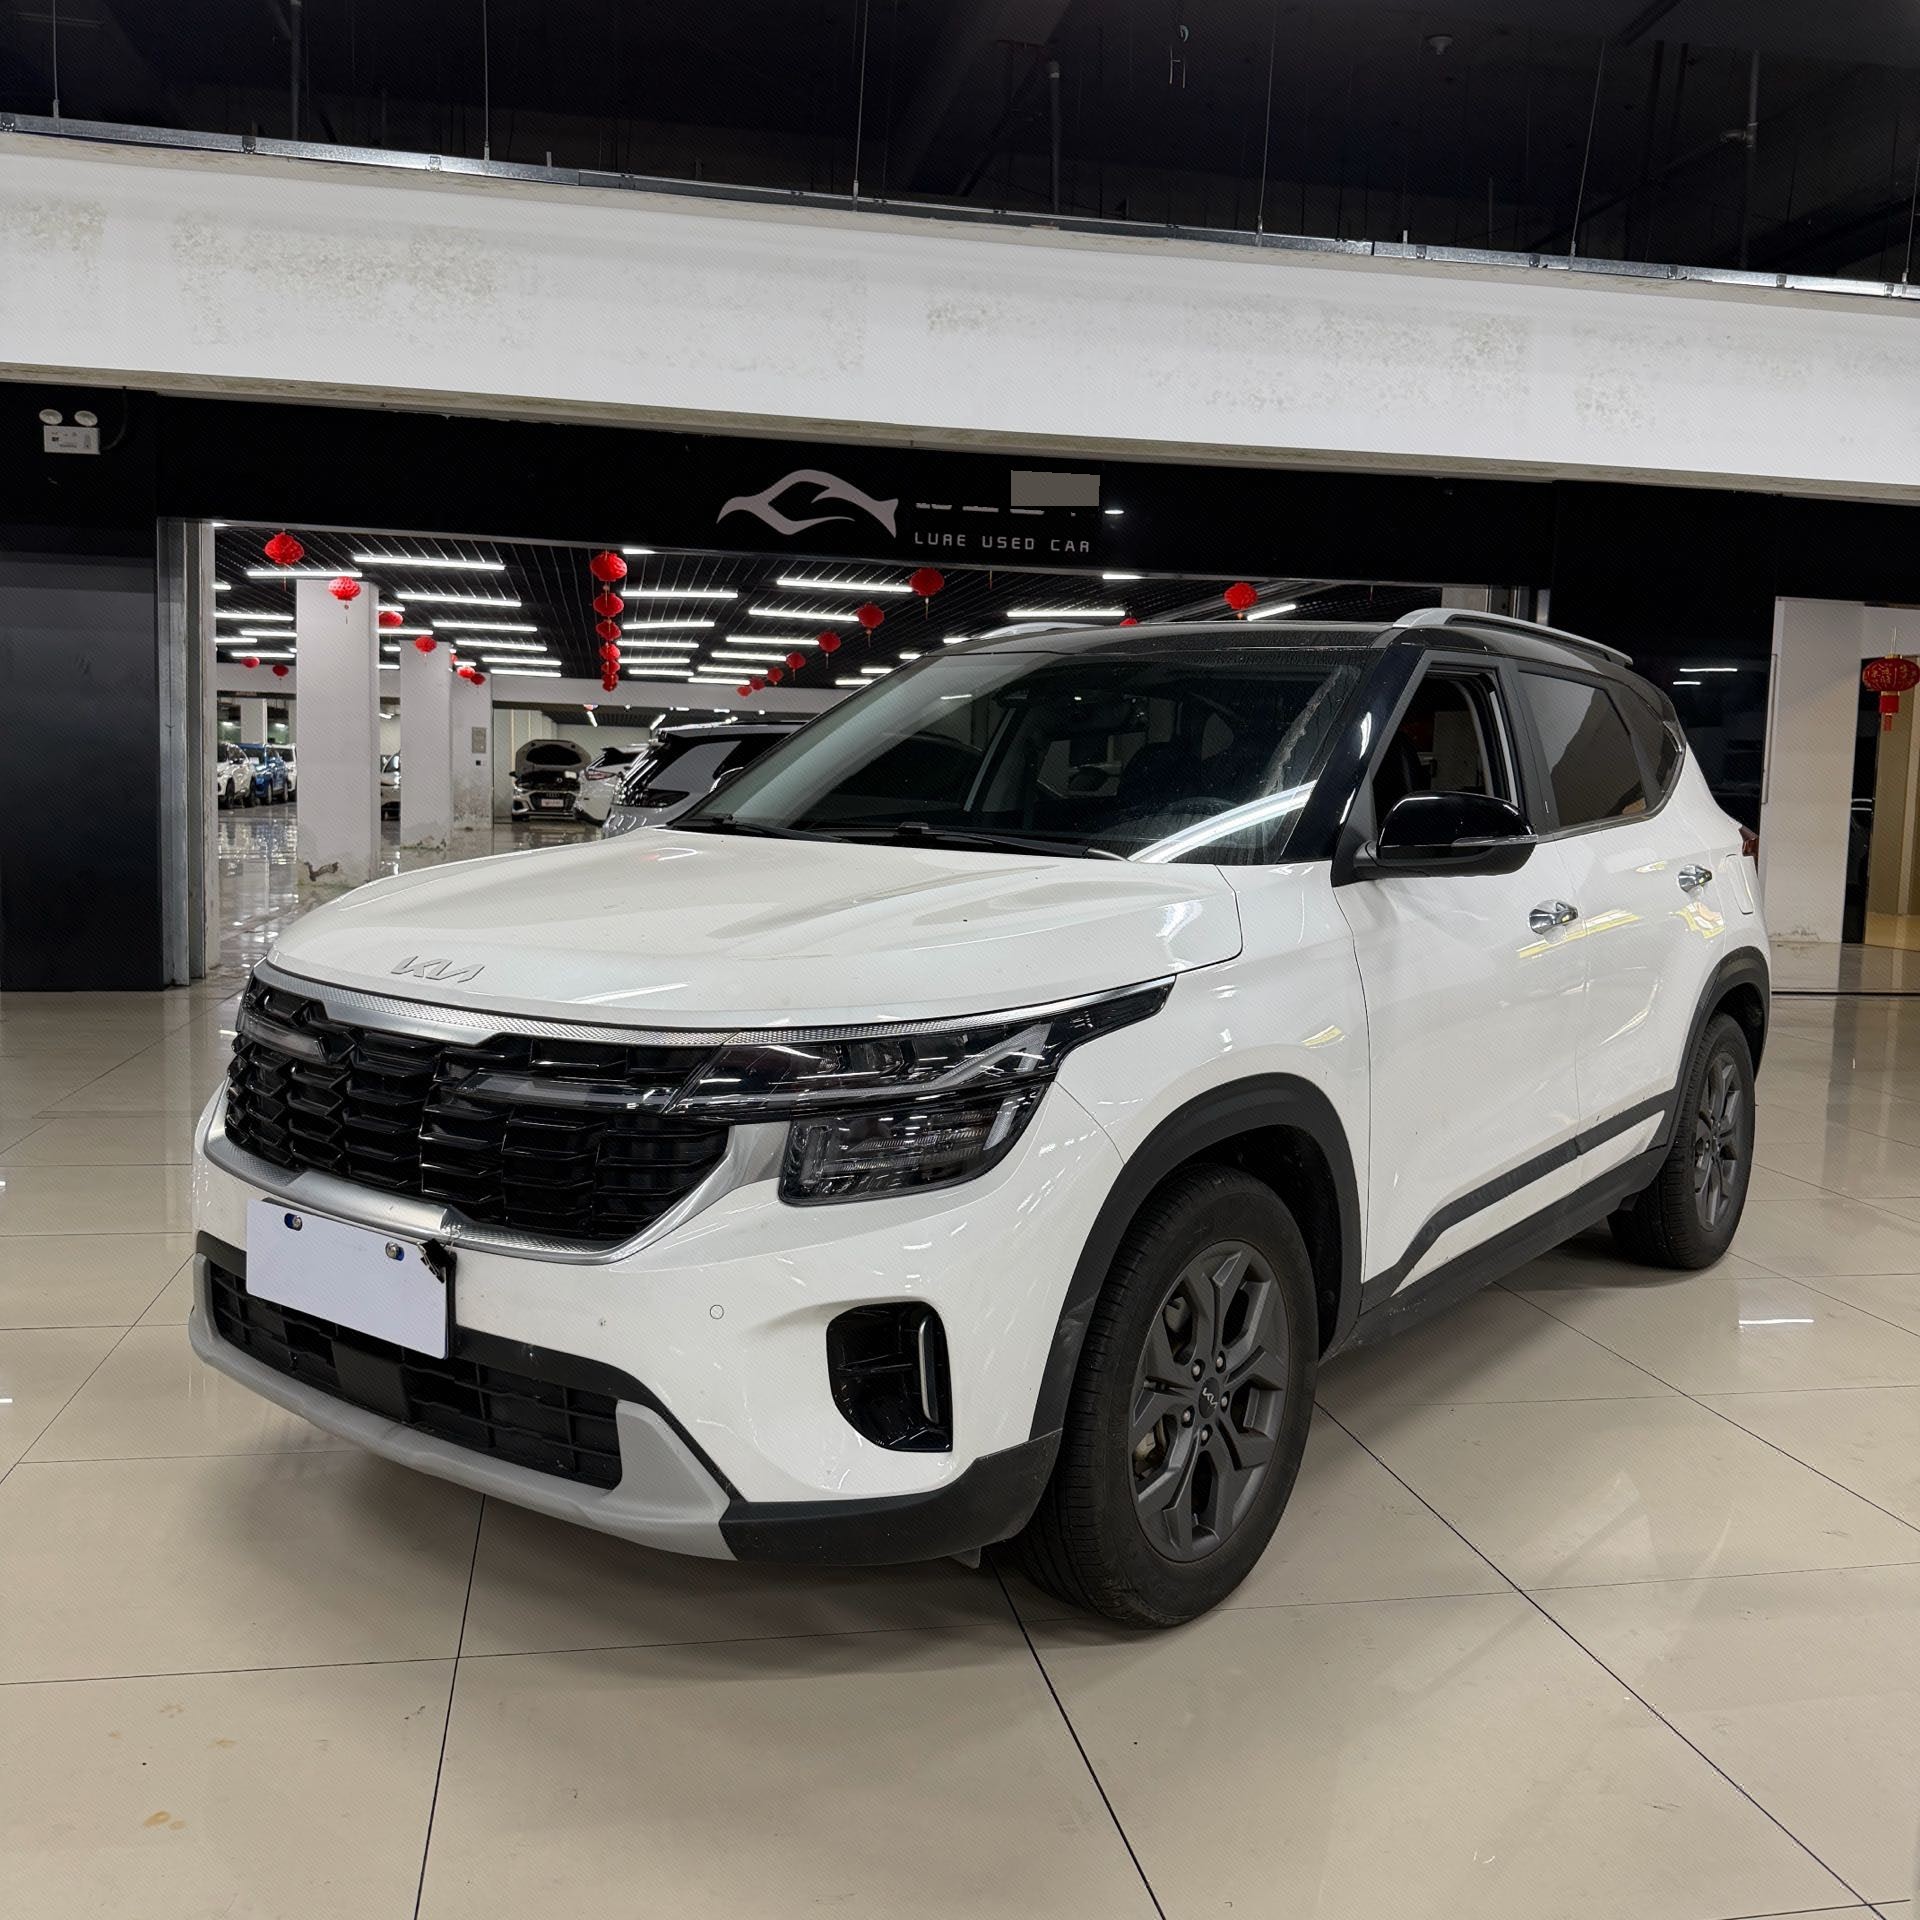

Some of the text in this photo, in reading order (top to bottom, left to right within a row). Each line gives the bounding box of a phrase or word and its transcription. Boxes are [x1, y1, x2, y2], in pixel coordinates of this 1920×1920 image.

[914, 531, 1090, 553] LURE USED CAR
[390, 954, 485, 984] KIA
